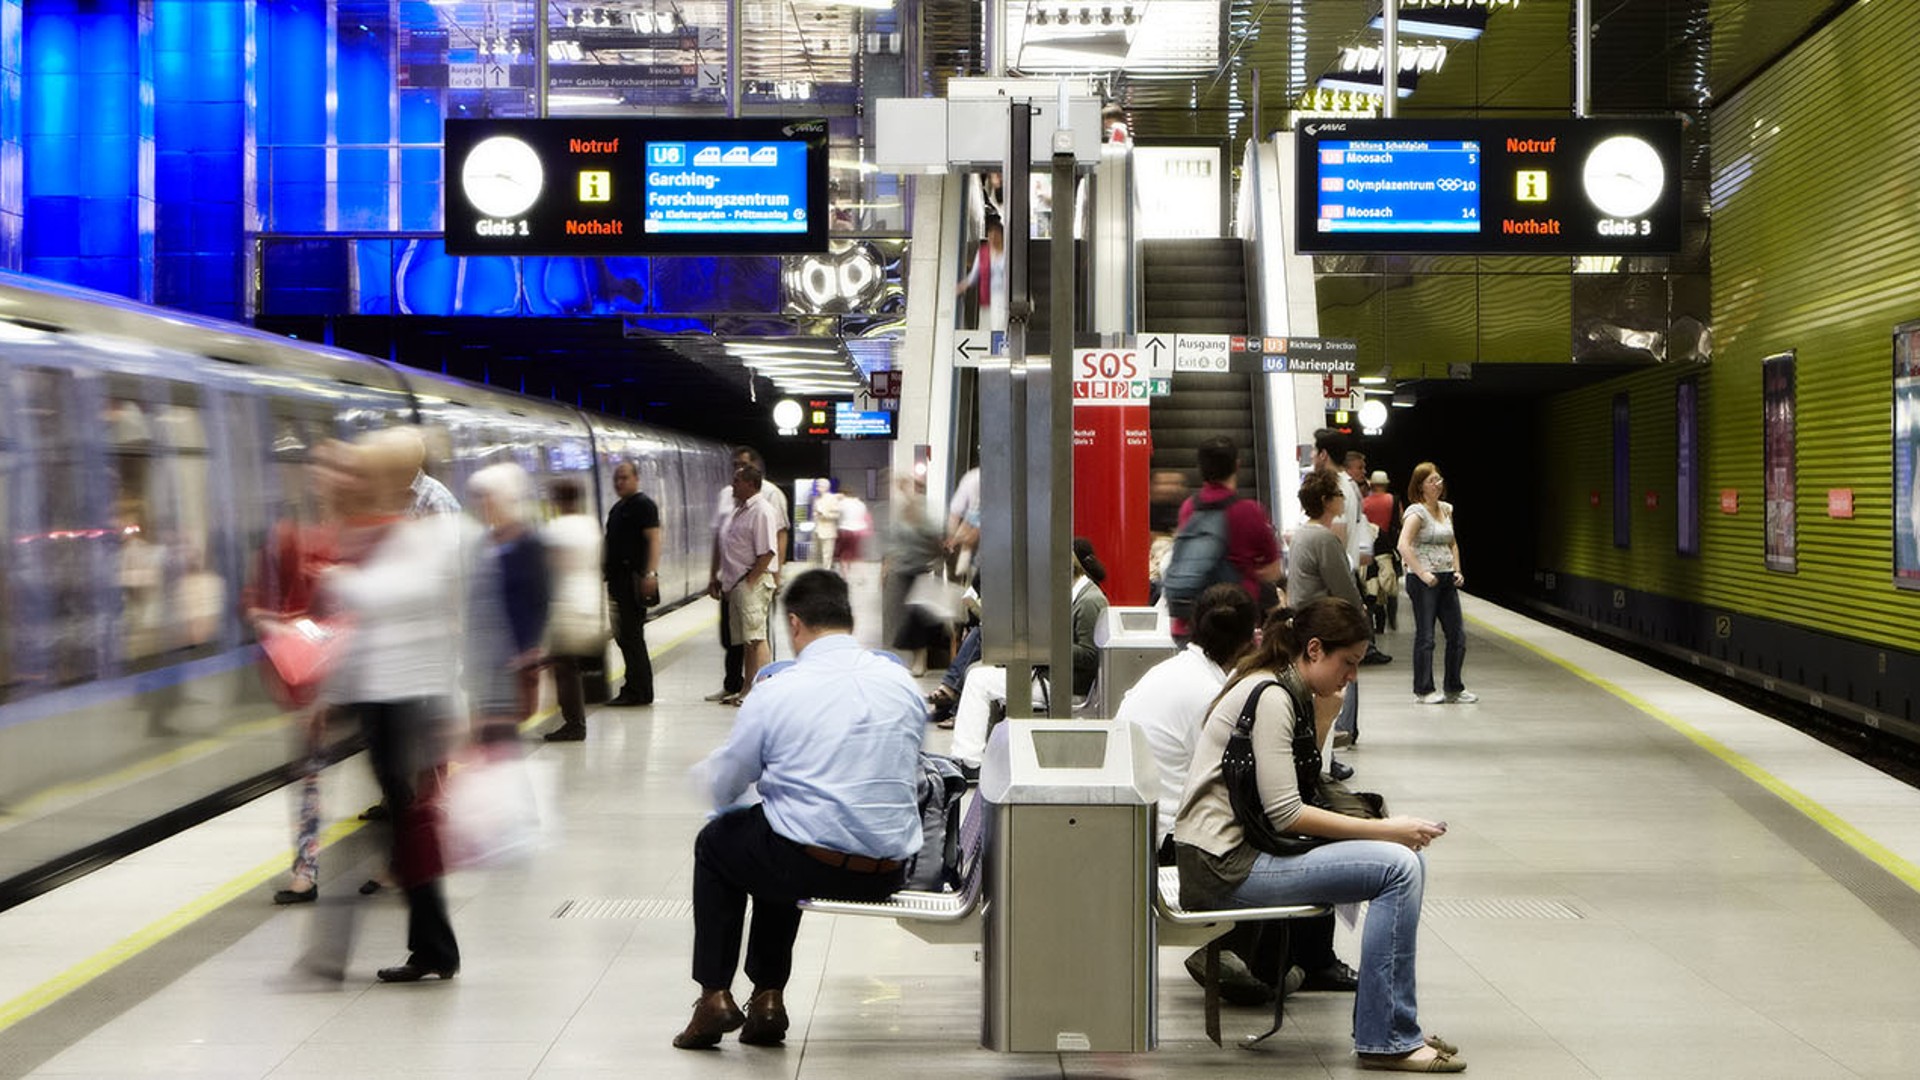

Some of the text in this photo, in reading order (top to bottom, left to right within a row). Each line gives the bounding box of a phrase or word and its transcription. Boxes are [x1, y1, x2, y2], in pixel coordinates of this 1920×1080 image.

[1318, 123, 1347, 131] MVG
[569, 138, 619, 153] Notruf
[1506, 137, 1557, 153] Notruf
[653, 147, 680, 163] U6
[1346, 152, 1393, 164] Moosach
[1468, 153, 1476, 165] 5
[648, 171, 721, 190] Garching-
[1346, 178, 1436, 193] Olympiazentrum
[1462, 180, 1477, 192] 10
[648, 191, 790, 209] Forschungszentrum
[1346, 206, 1394, 218] Moosach
[1462, 207, 1477, 219] 14
[475, 218, 530, 236] Gleis 1
[565, 219, 623, 235] Nothalt
[1502, 218, 1561, 235] Nothalt
[1597, 219, 1651, 236] Gleis 3
[1178, 338, 1226, 352] Ausgang
[1267, 339, 1284, 351] U3
[1290, 340, 1322, 351] Richtung
[1325, 340, 1356, 351] Direction
[1082, 353, 1137, 379] SOS
[1178, 356, 1197, 368] Exit
[1266, 357, 1285, 370] U6
[1289, 358, 1355, 372] Marienplatz
